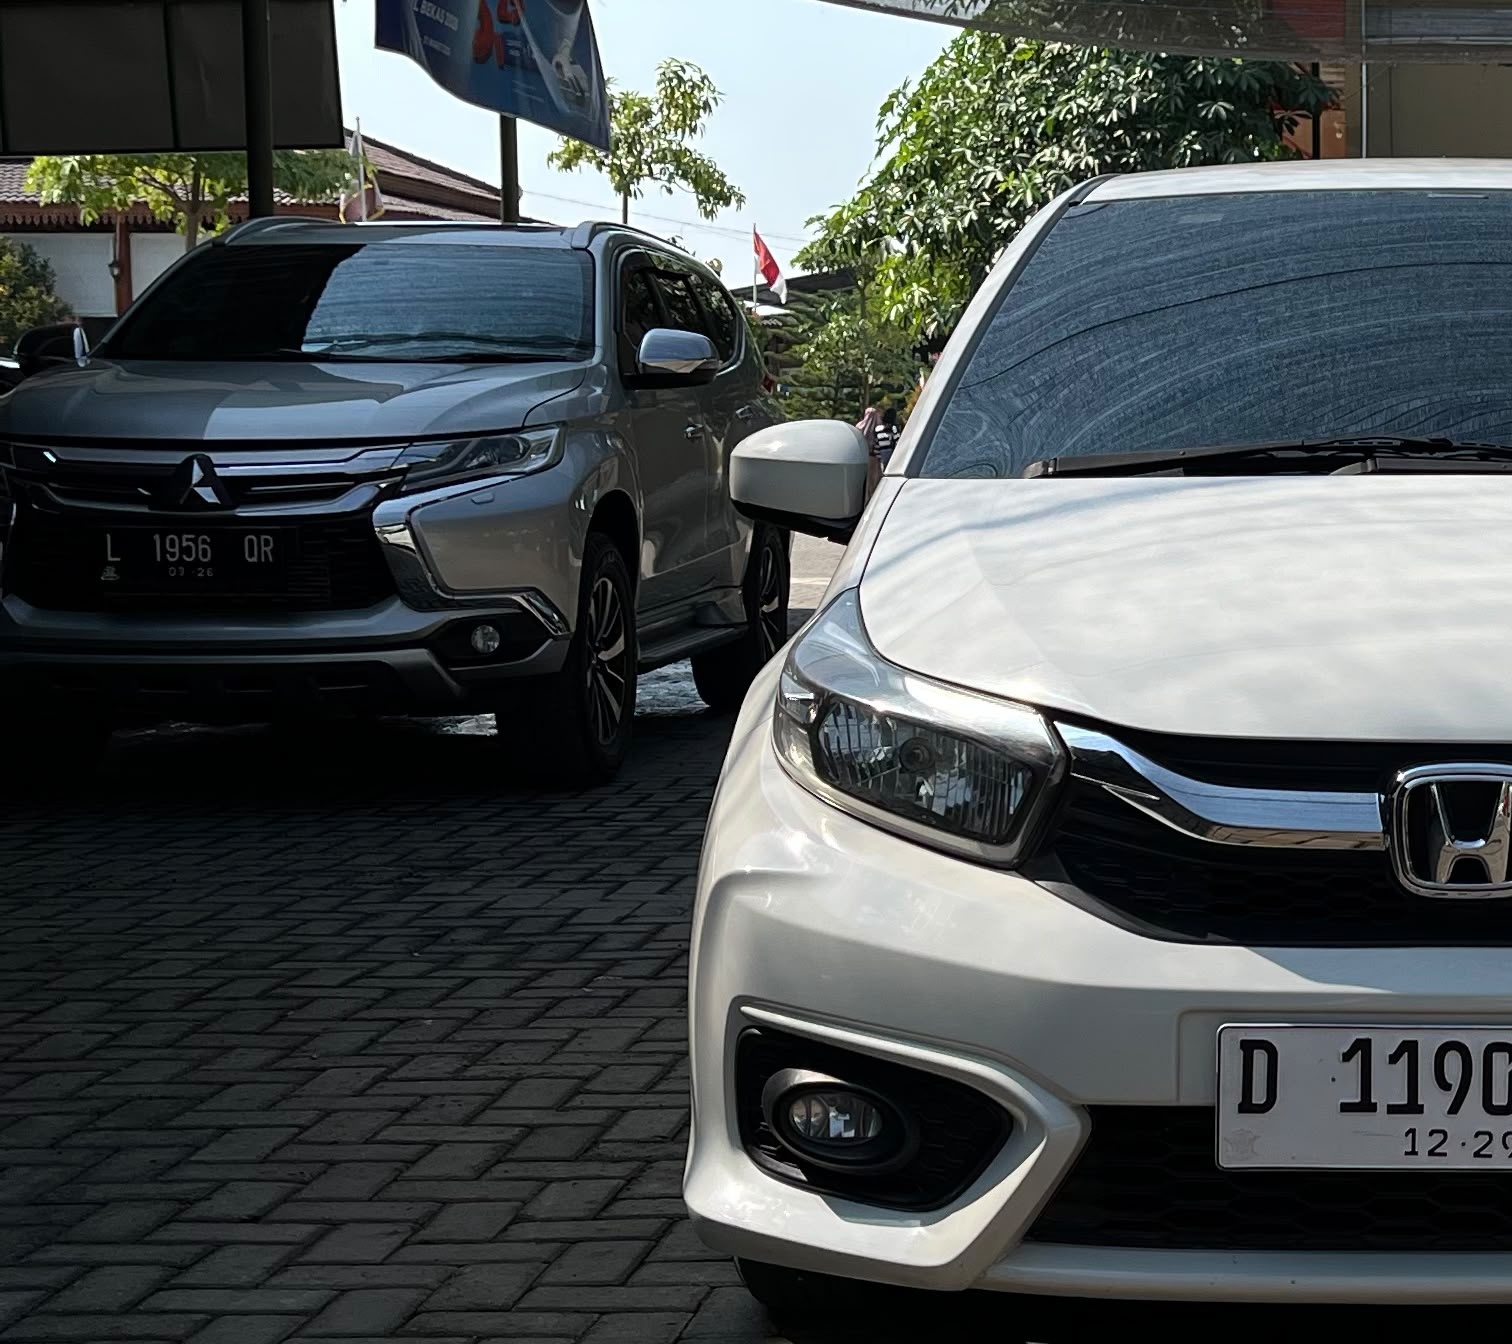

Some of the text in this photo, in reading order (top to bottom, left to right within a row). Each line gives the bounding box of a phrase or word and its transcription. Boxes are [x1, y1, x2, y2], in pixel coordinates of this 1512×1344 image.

[106, 533, 274, 563] L 1956 QR
[1237, 1038, 1279, 1114] D
